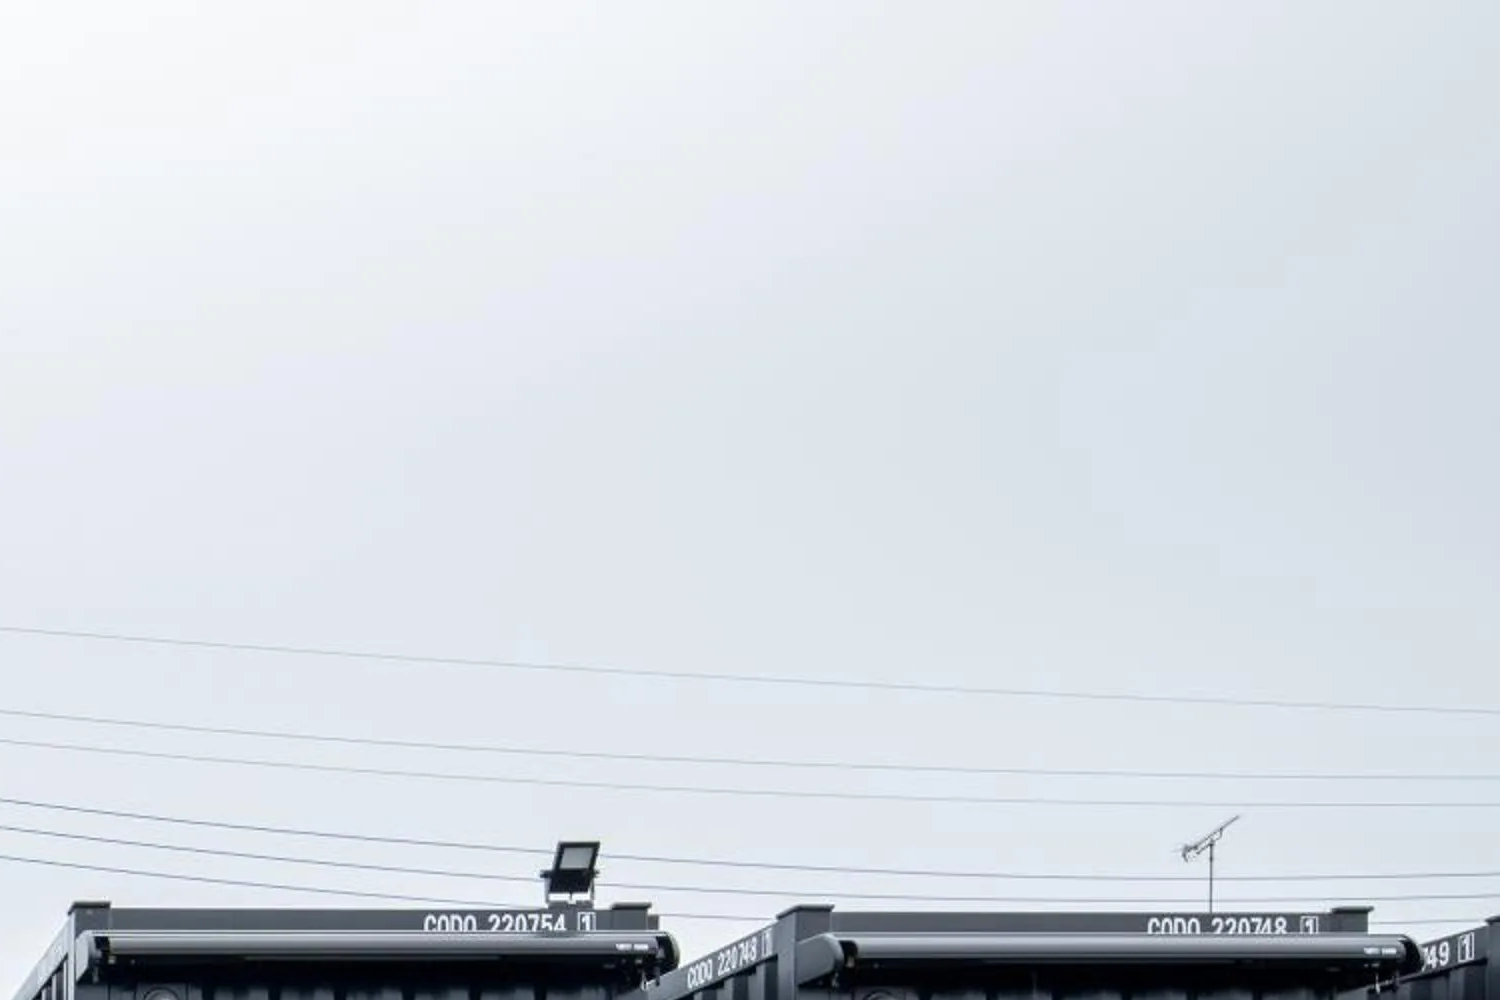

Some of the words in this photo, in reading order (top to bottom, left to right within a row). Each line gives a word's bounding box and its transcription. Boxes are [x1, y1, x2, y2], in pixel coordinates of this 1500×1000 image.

[423, 913, 477, 932] CODO
[487, 913, 567, 932] 220754
[1147, 917, 1200, 934] CODO
[1211, 917, 1287, 934] 220748
[1421, 941, 1449, 972] 749
